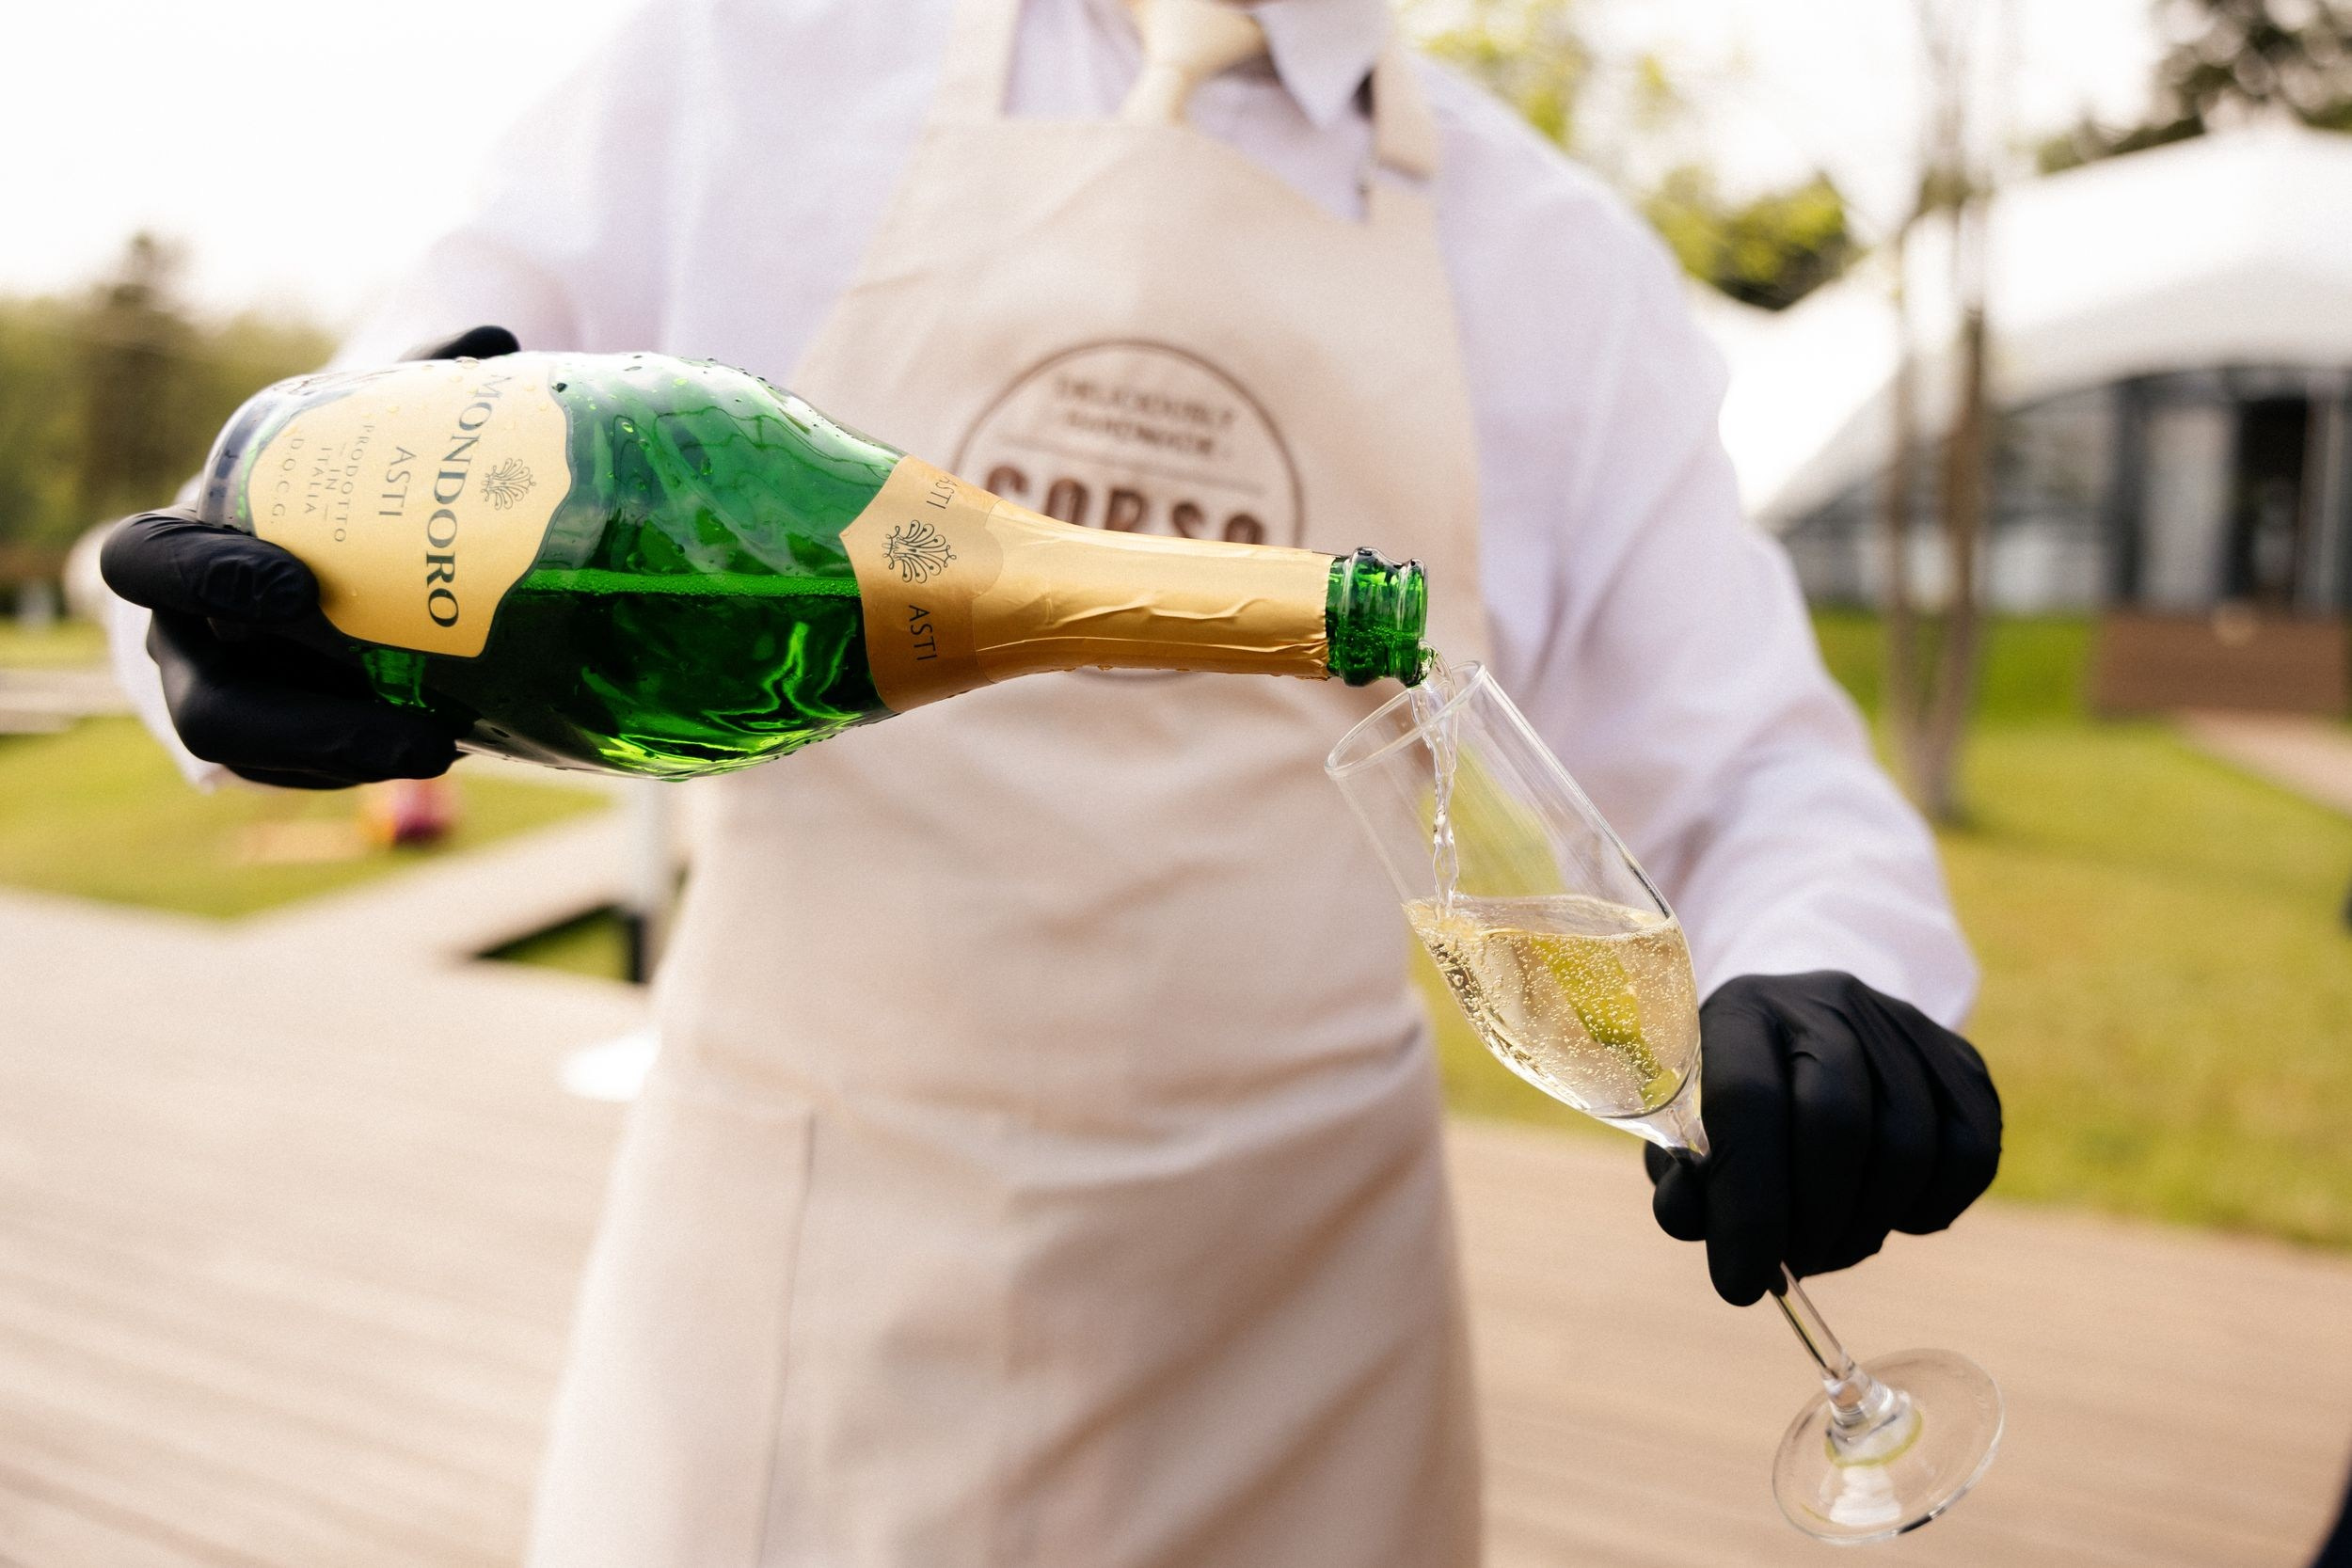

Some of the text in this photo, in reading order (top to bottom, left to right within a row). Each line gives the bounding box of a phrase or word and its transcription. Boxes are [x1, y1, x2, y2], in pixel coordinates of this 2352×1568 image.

[304, 447, 332, 514] ITALIA
[325, 468, 342, 490] IN
[334, 424, 375, 543] PRODOTTO
[378, 446, 417, 516] ASTI
[425, 375, 513, 628] MONDORO
[926, 475, 958, 509] ASTI
[908, 603, 938, 661] ASTI
